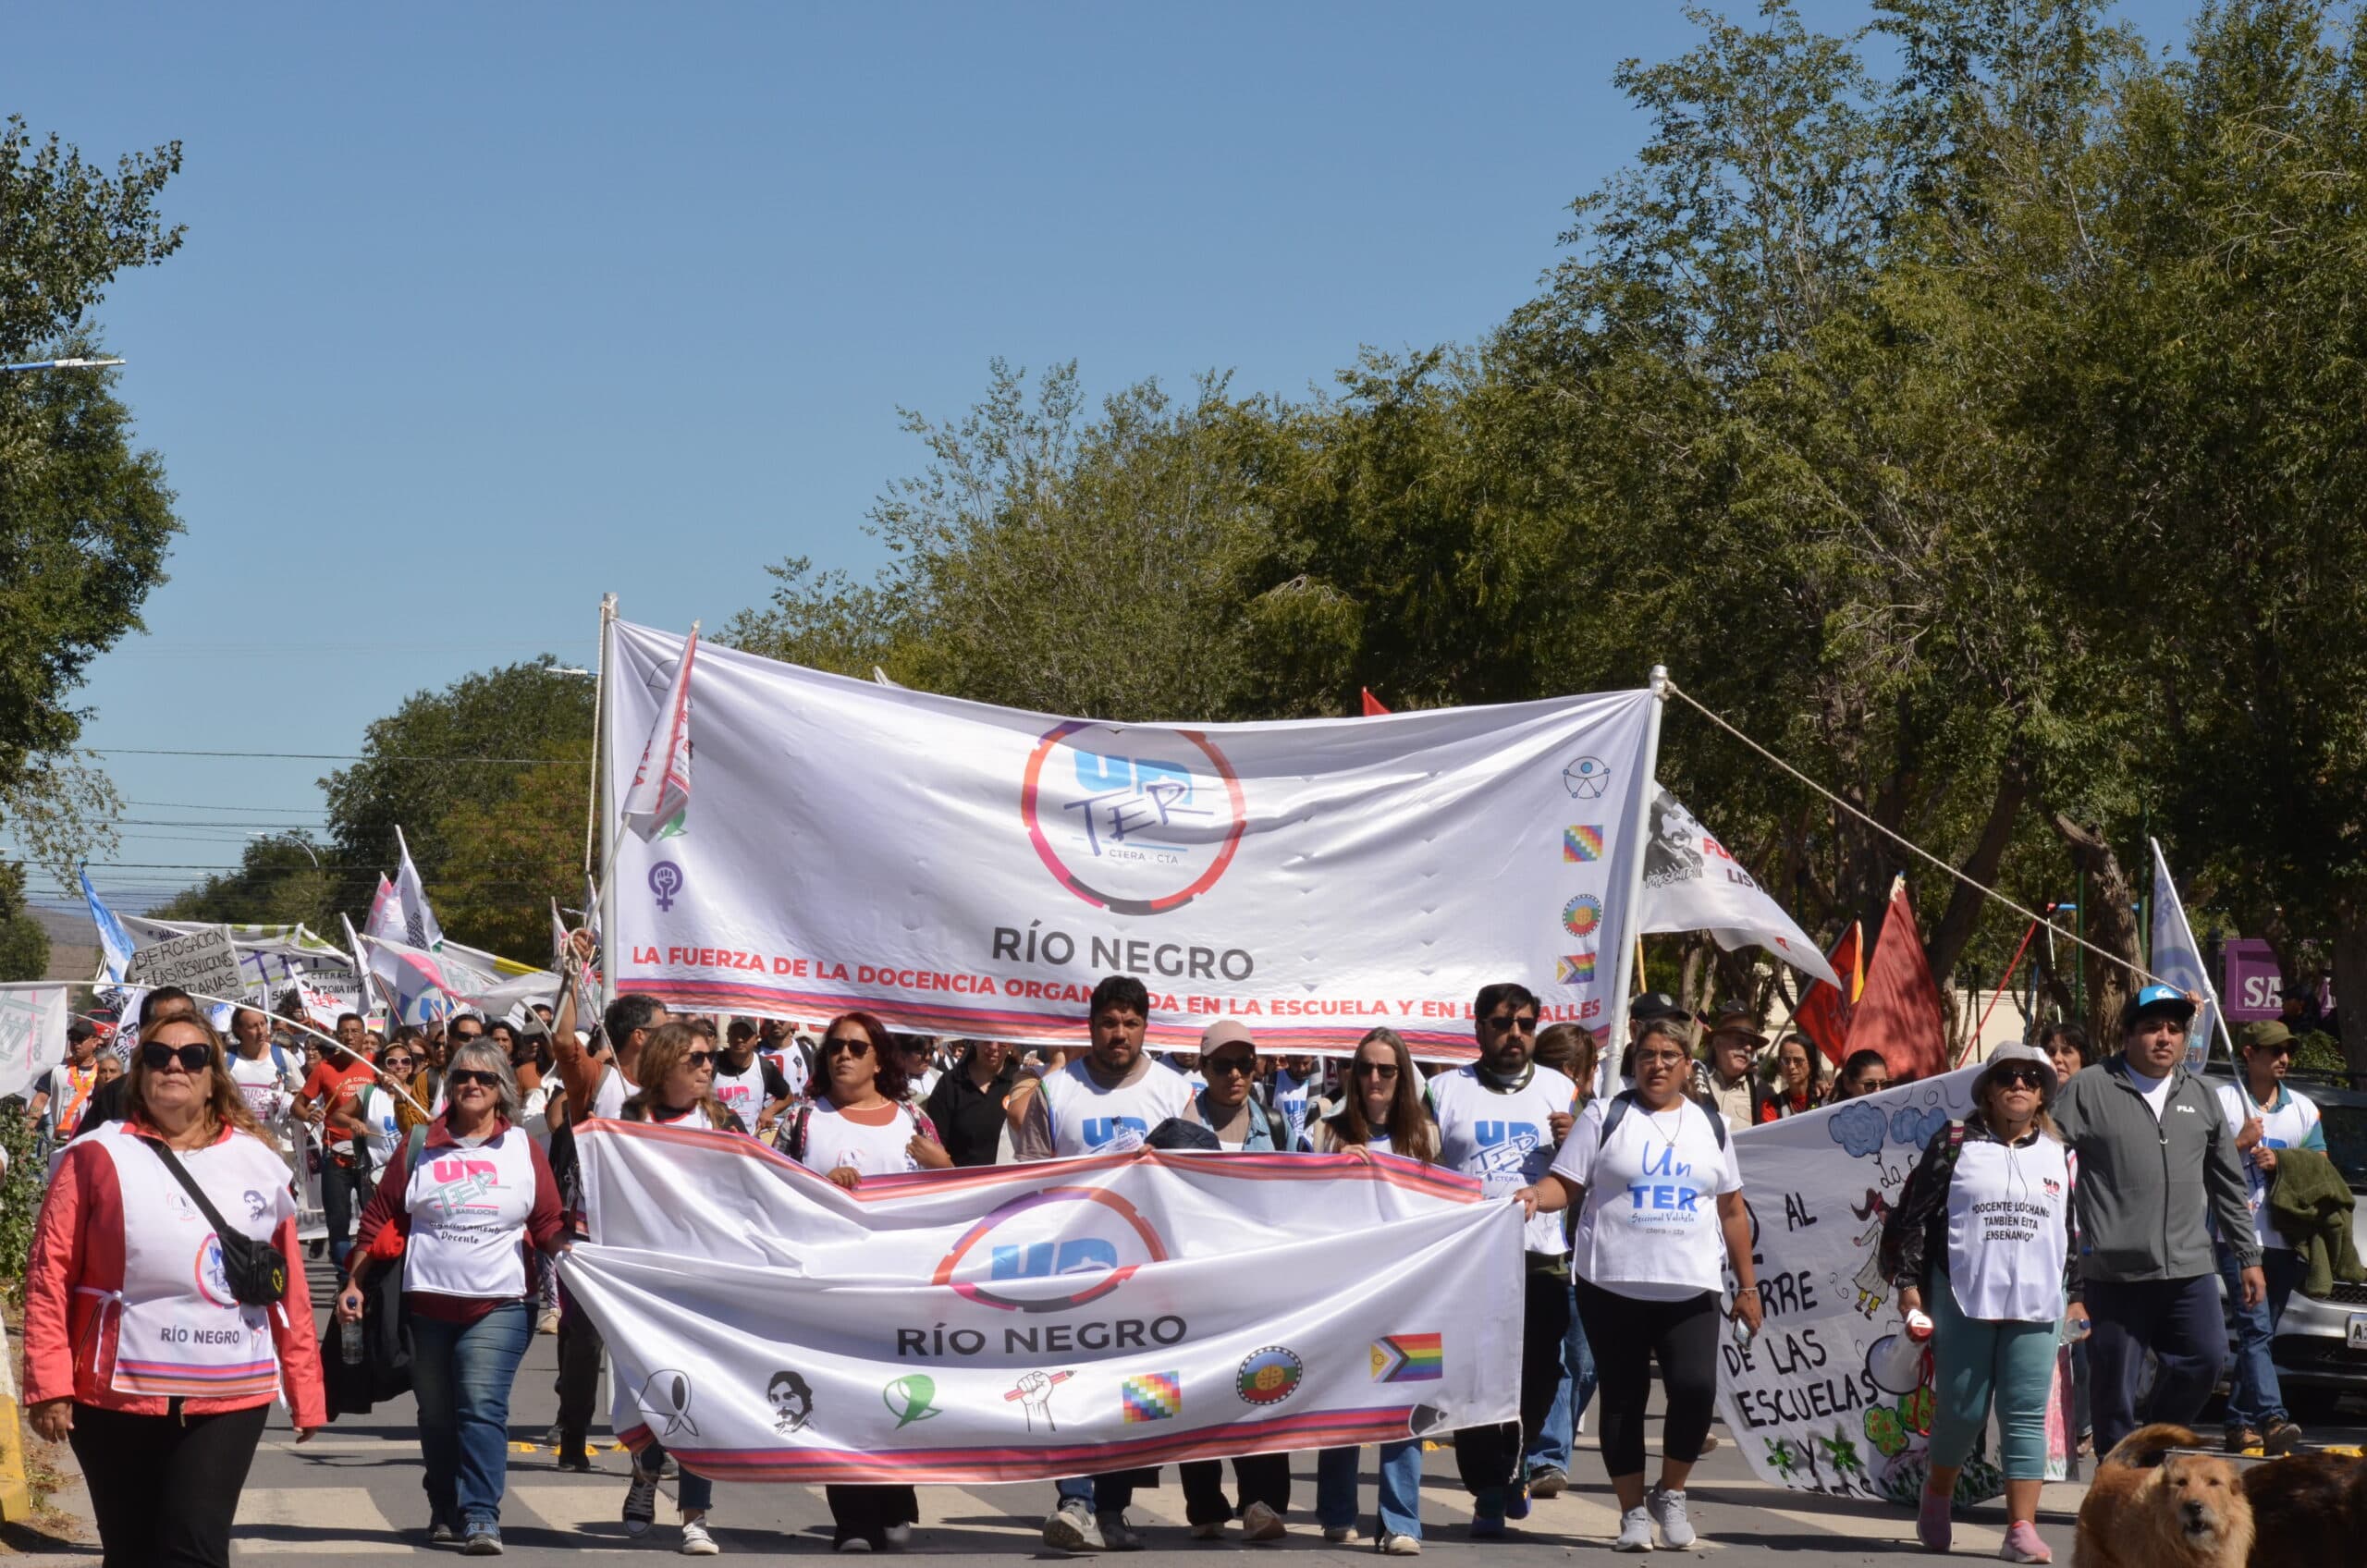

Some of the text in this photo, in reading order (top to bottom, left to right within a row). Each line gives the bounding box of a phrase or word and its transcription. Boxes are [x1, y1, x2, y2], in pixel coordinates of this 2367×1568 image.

[1064, 784, 1214, 856] TER
[1110, 850, 1146, 861] CTERA
[1157, 855, 1179, 864] CTA
[992, 918, 1254, 981] RÍO NEGRO
[632, 946, 662, 964] LA
[668, 947, 766, 975] FUERZA
[773, 957, 808, 978] DE
[816, 961, 850, 982] LA
[857, 965, 997, 996] DOCENCIA
[1186, 995, 1220, 1015] EN
[1228, 997, 1263, 1016] LA
[1270, 998, 1390, 1017] ESCUELA
[1390, 998, 1414, 1017] Y
[1421, 999, 1456, 1019] EN
[1536, 998, 1600, 1023] ALLES
[428, 1172, 510, 1218] TER
[1627, 1183, 1698, 1213] TER
[1784, 1192, 1818, 1232] AL
[441, 1231, 480, 1244] Docente
[161, 1324, 240, 1345] RÍO NEGRO
[897, 1315, 1188, 1357] RÍO NEGRO
[1722, 1329, 1827, 1378] DE LAS
[1735, 1367, 1879, 1427] ESCUELAS
